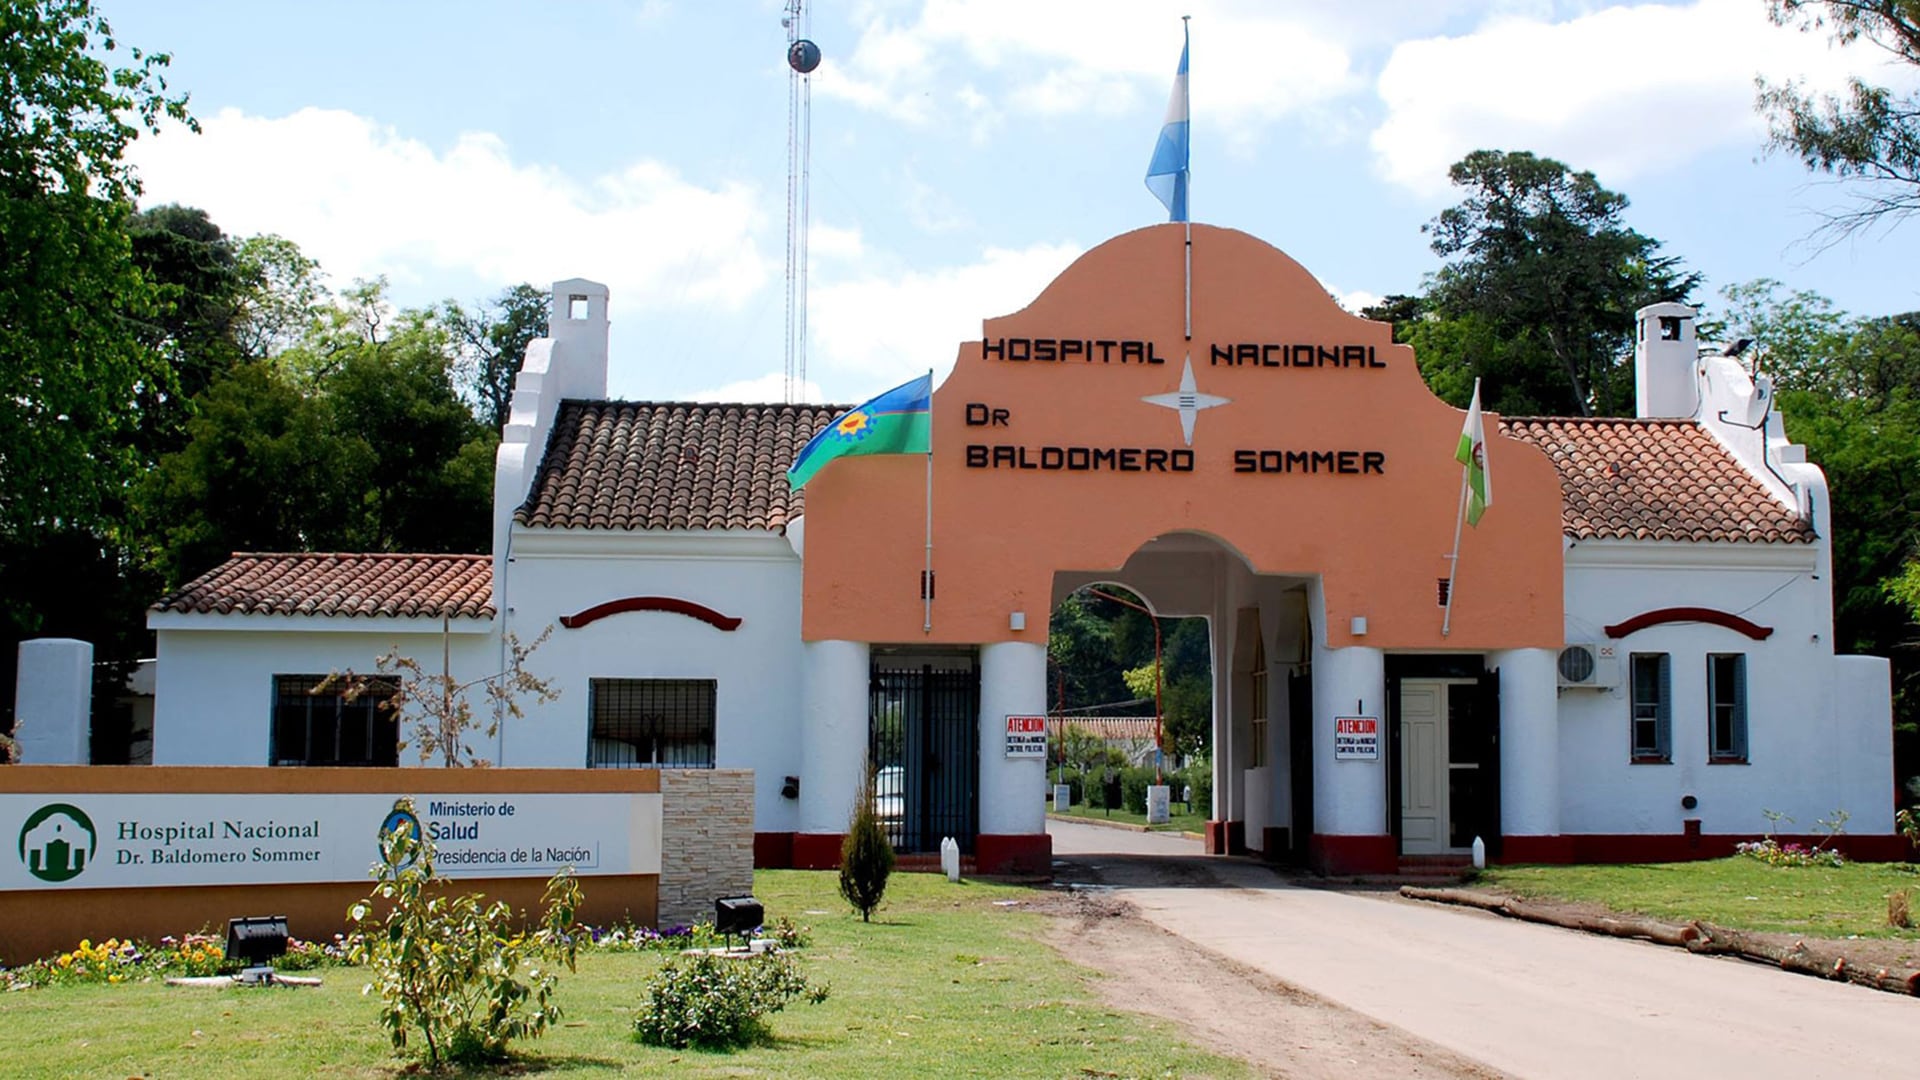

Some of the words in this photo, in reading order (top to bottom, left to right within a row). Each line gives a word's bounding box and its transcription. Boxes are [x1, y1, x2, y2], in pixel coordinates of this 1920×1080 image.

[982, 337, 1165, 364] HOSPITAL
[1210, 343, 1387, 368] NACIONAL
[965, 445, 1195, 472] BALDOMERO
[1234, 449, 1386, 474] SOMMER
[1007, 718, 1044, 732] ATENCION
[1337, 720, 1376, 733] ATENCION
[429, 801, 496, 816] Ministerio
[498, 801, 515, 816] de
[117, 820, 215, 845] Hospital
[223, 820, 320, 839] Nacional
[429, 821, 479, 840] Salud
[116, 849, 144, 865] Dr.
[151, 848, 247, 864] Baldomero
[252, 847, 321, 863] Sommer
[510, 847, 528, 863] de
[531, 847, 542, 862] la
[546, 846, 591, 862] Nación
